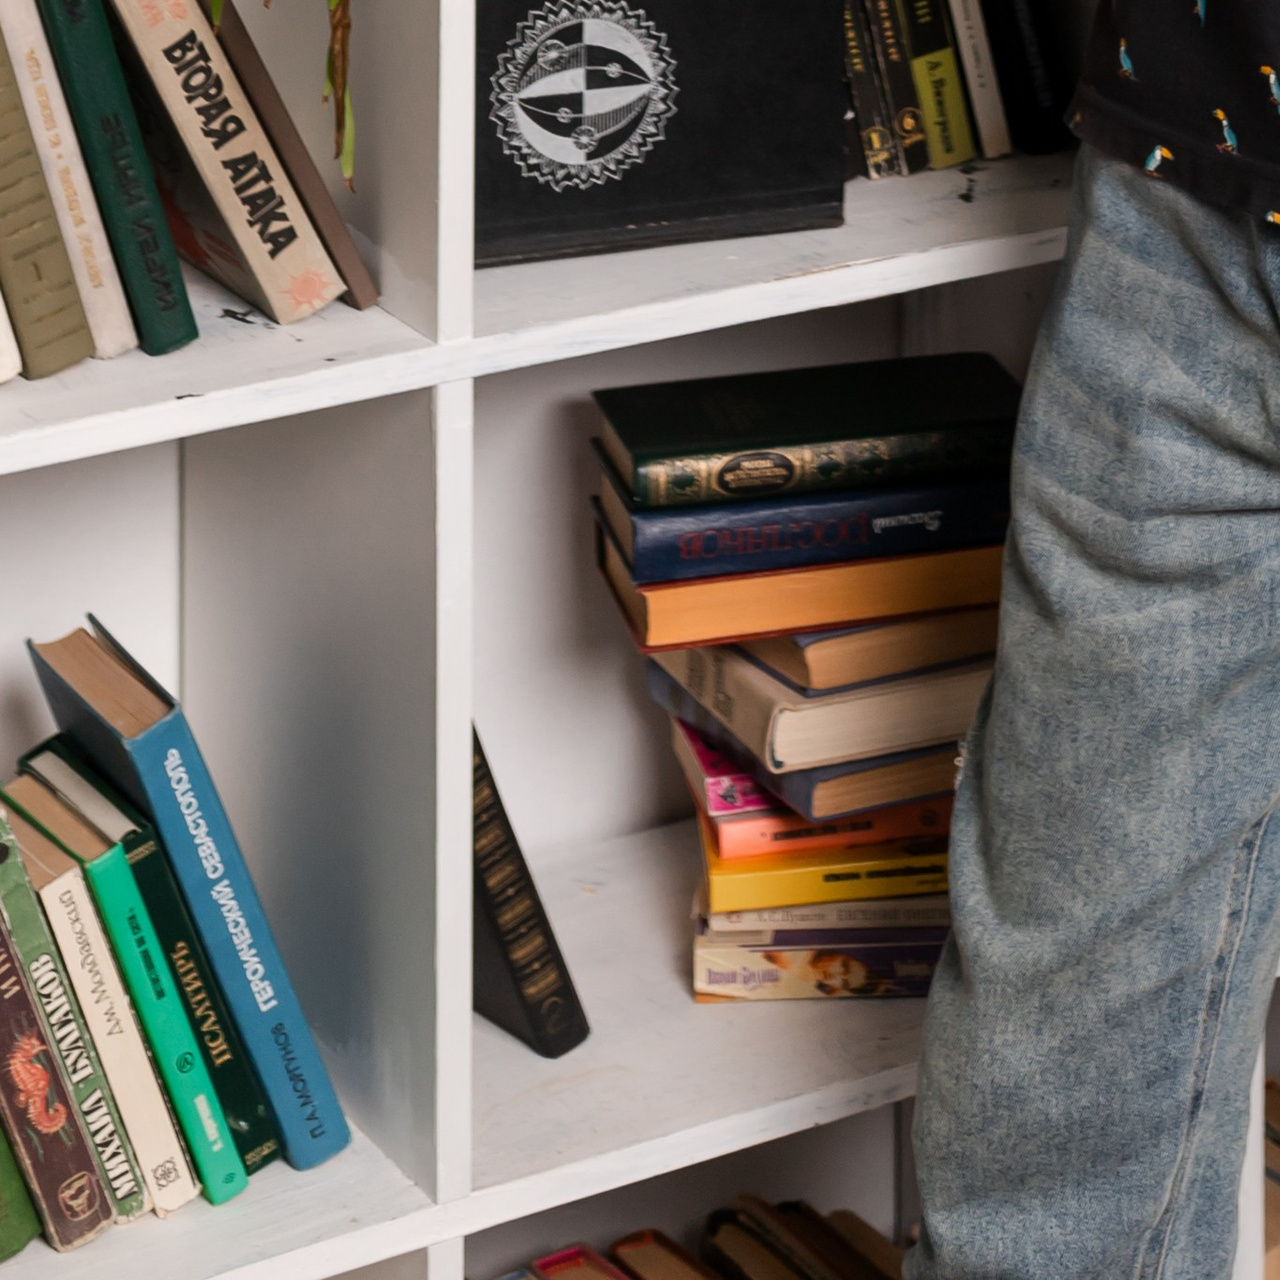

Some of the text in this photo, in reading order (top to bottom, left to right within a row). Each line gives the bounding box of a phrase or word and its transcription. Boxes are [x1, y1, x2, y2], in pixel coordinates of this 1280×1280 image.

[162, 29, 298, 260] ВТОРАЯ АТАКА
[57, 889, 114, 1002] Молдавский
[166, 747, 278, 1012] ГЕРОИЧЕСКИЙ СЕВАСТОПОЛЬ
[28, 953, 137, 1201] МИХАИЛ БУЛГАКОВ
[174, 941, 234, 1068] ПСАЛТИРЬ
